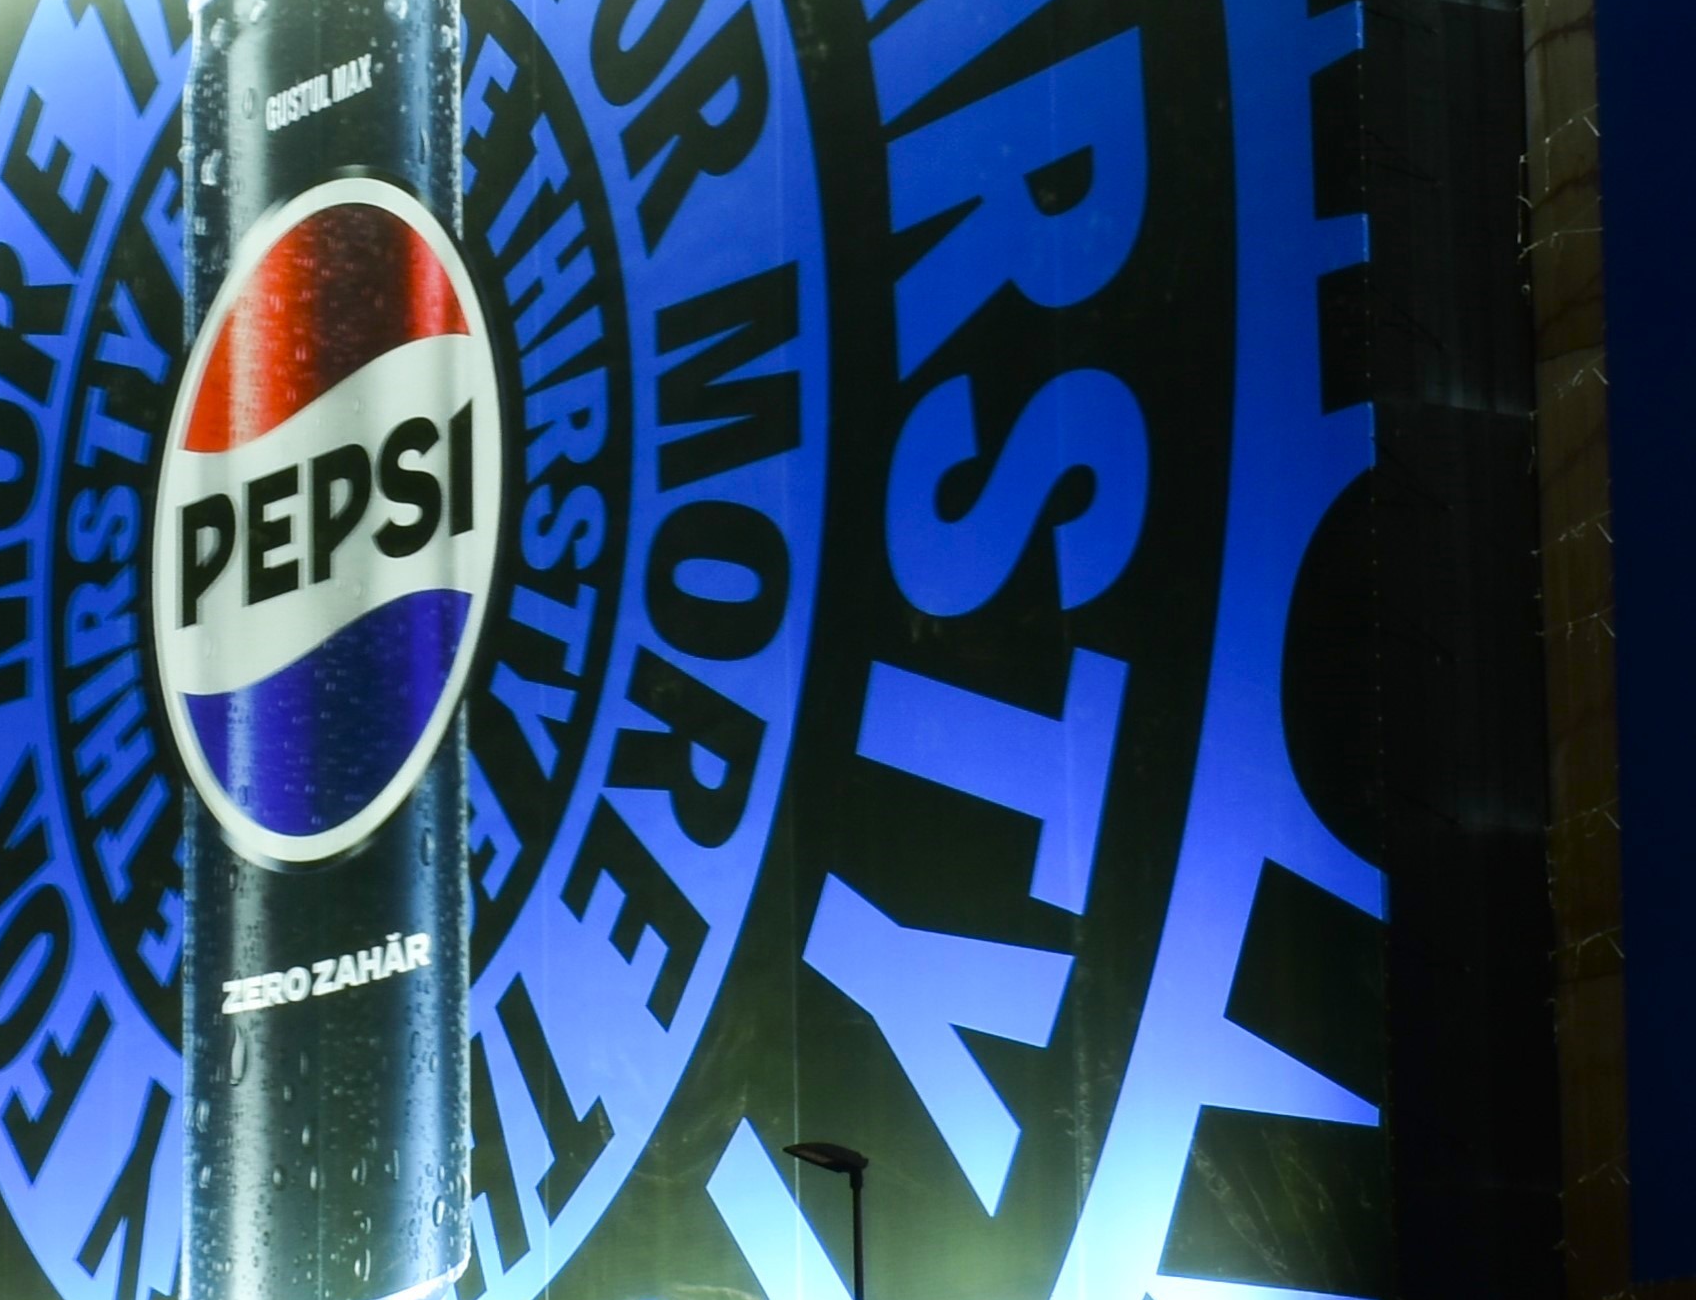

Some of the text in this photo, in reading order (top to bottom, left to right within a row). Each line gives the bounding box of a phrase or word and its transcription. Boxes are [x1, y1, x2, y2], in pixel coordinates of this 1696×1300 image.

[265, 53, 373, 132] GUSTUL MAX
[65, 279, 173, 905] THIRSTY
[176, 396, 475, 628] PEPSI
[485, 111, 610, 783] THIRSTY
[560, 260, 802, 1033] MORE
[221, 931, 431, 1014] ZERO ZAHĂR
